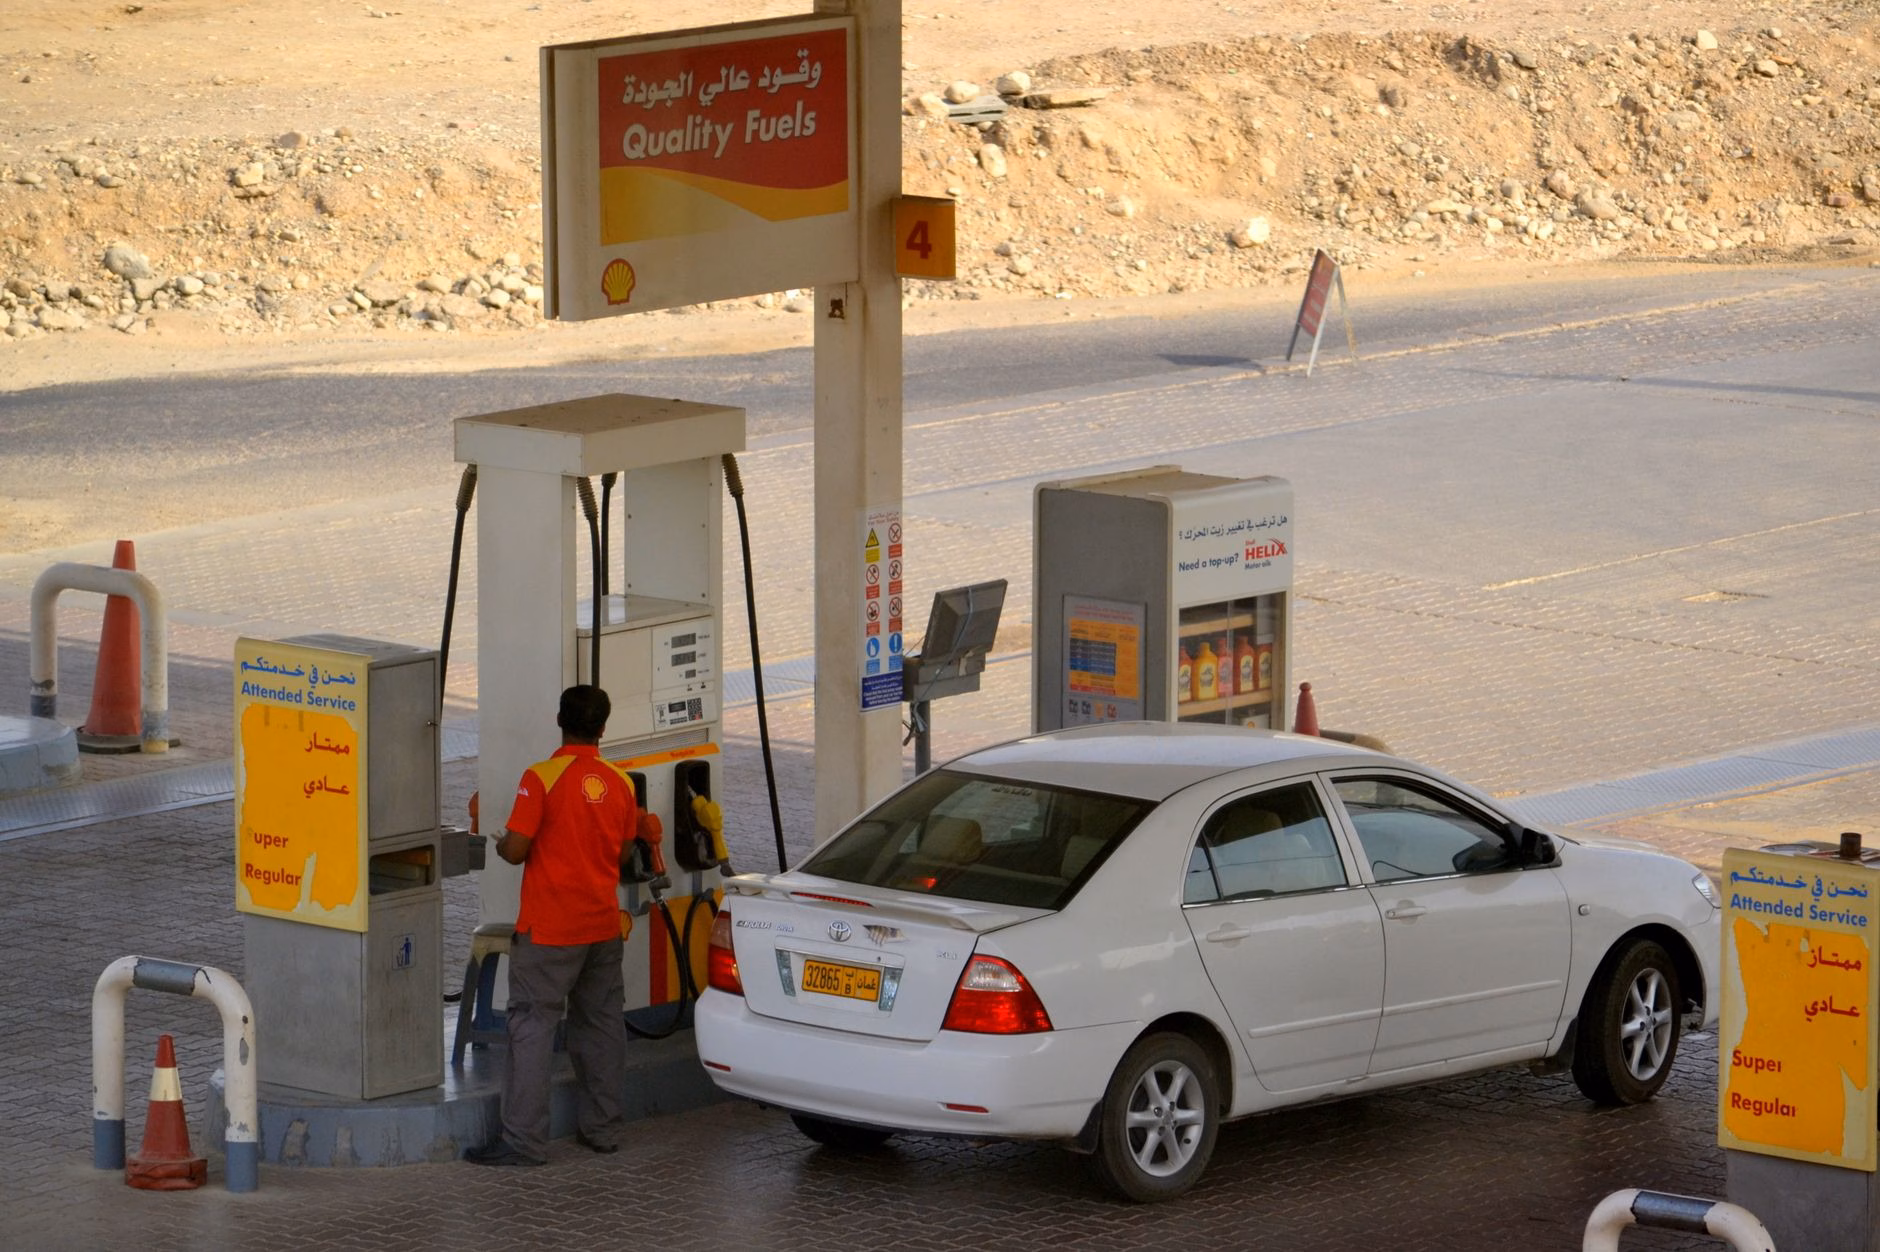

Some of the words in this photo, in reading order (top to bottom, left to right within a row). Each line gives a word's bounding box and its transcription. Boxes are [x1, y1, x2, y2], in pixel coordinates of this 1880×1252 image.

[757, 47, 822, 93] وقود
[622, 69, 694, 110] الجودة
[698, 63, 751, 107] عالي
[622, 114, 734, 159] Quality
[744, 99, 817, 144] Fuels
[905, 220, 932, 259] 4
[1277, 515, 1288, 527] هل
[1179, 557, 1200, 572] Need
[1202, 560, 1207, 568] a
[1209, 552, 1239, 568] top-up?
[1245, 540, 1288, 561] HELIX
[240, 656, 305, 677] خدمتكم
[308, 664, 319, 689] في
[322, 670, 356, 685] نحن
[241, 681, 303, 704] Attended
[307, 691, 356, 711] Service
[303, 775, 350, 799] عادي
[247, 828, 289, 850] uper
[245, 863, 302, 886] Regular
[1730, 866, 1807, 888] خدمتكم
[1811, 875, 1823, 902] في
[1827, 882, 1868, 898] نحن
[1730, 893, 1804, 918] Attended
[1809, 904, 1868, 927] Service
[1807, 945, 1862, 971] ممتاز
[805, 965, 841, 991] 32865
[844, 983, 852, 995] B
[1804, 994, 1860, 1023] عادي
